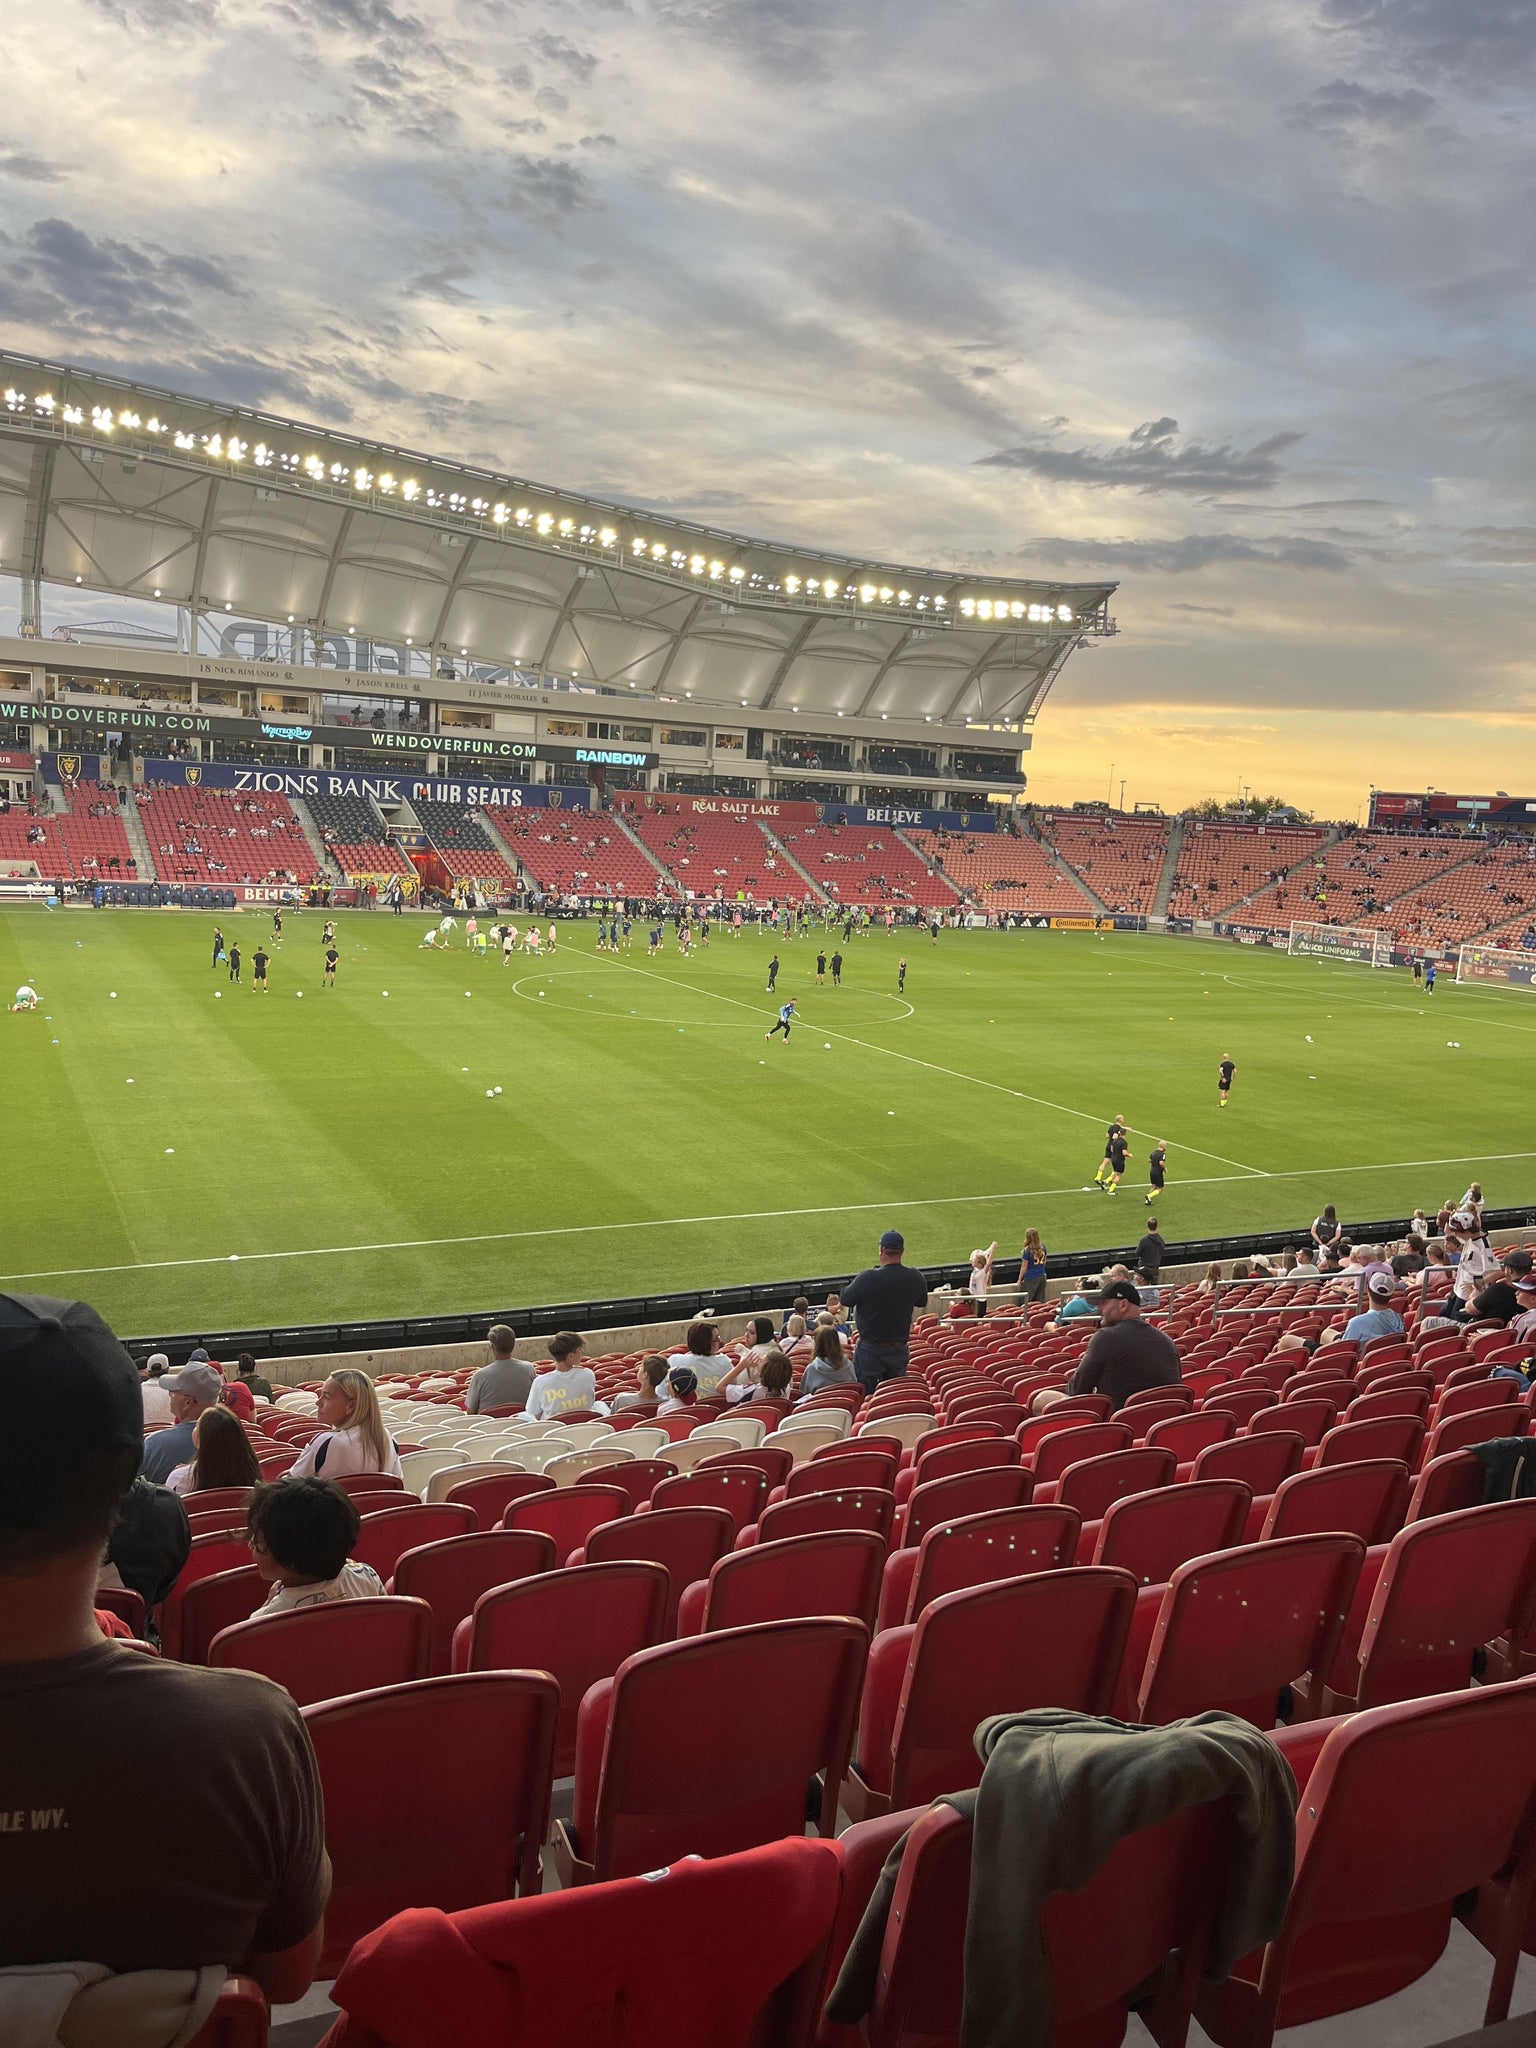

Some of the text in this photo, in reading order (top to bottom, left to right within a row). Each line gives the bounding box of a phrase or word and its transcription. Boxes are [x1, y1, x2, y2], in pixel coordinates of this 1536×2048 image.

[200, 664, 279, 678] 18 NICK RIMANDO
[344, 677, 408, 690] 9 JASON KREIS
[478, 690, 503, 700] JAVIER
[505, 693, 538, 702] MORALES
[1, 703, 211, 731] WENDOVERFUN.COM
[371, 733, 537, 758] WENDOVERFUN.COM
[576, 749, 647, 766] RAINBOW
[234, 770, 402, 800] ZIONS BANK
[412, 782, 522, 807] CLUB SEATS
[721, 802, 749, 814] SALT
[751, 804, 780, 816] LAKE
[866, 808, 922, 824] BELIEVE
[1055, 919, 1090, 928] Continental
[1324, 946, 1361, 957] UNIFORMS
[545, 1387, 566, 1402] Do
[561, 1395, 588, 1410] not
[31, 1808, 69, 1830] WY.
